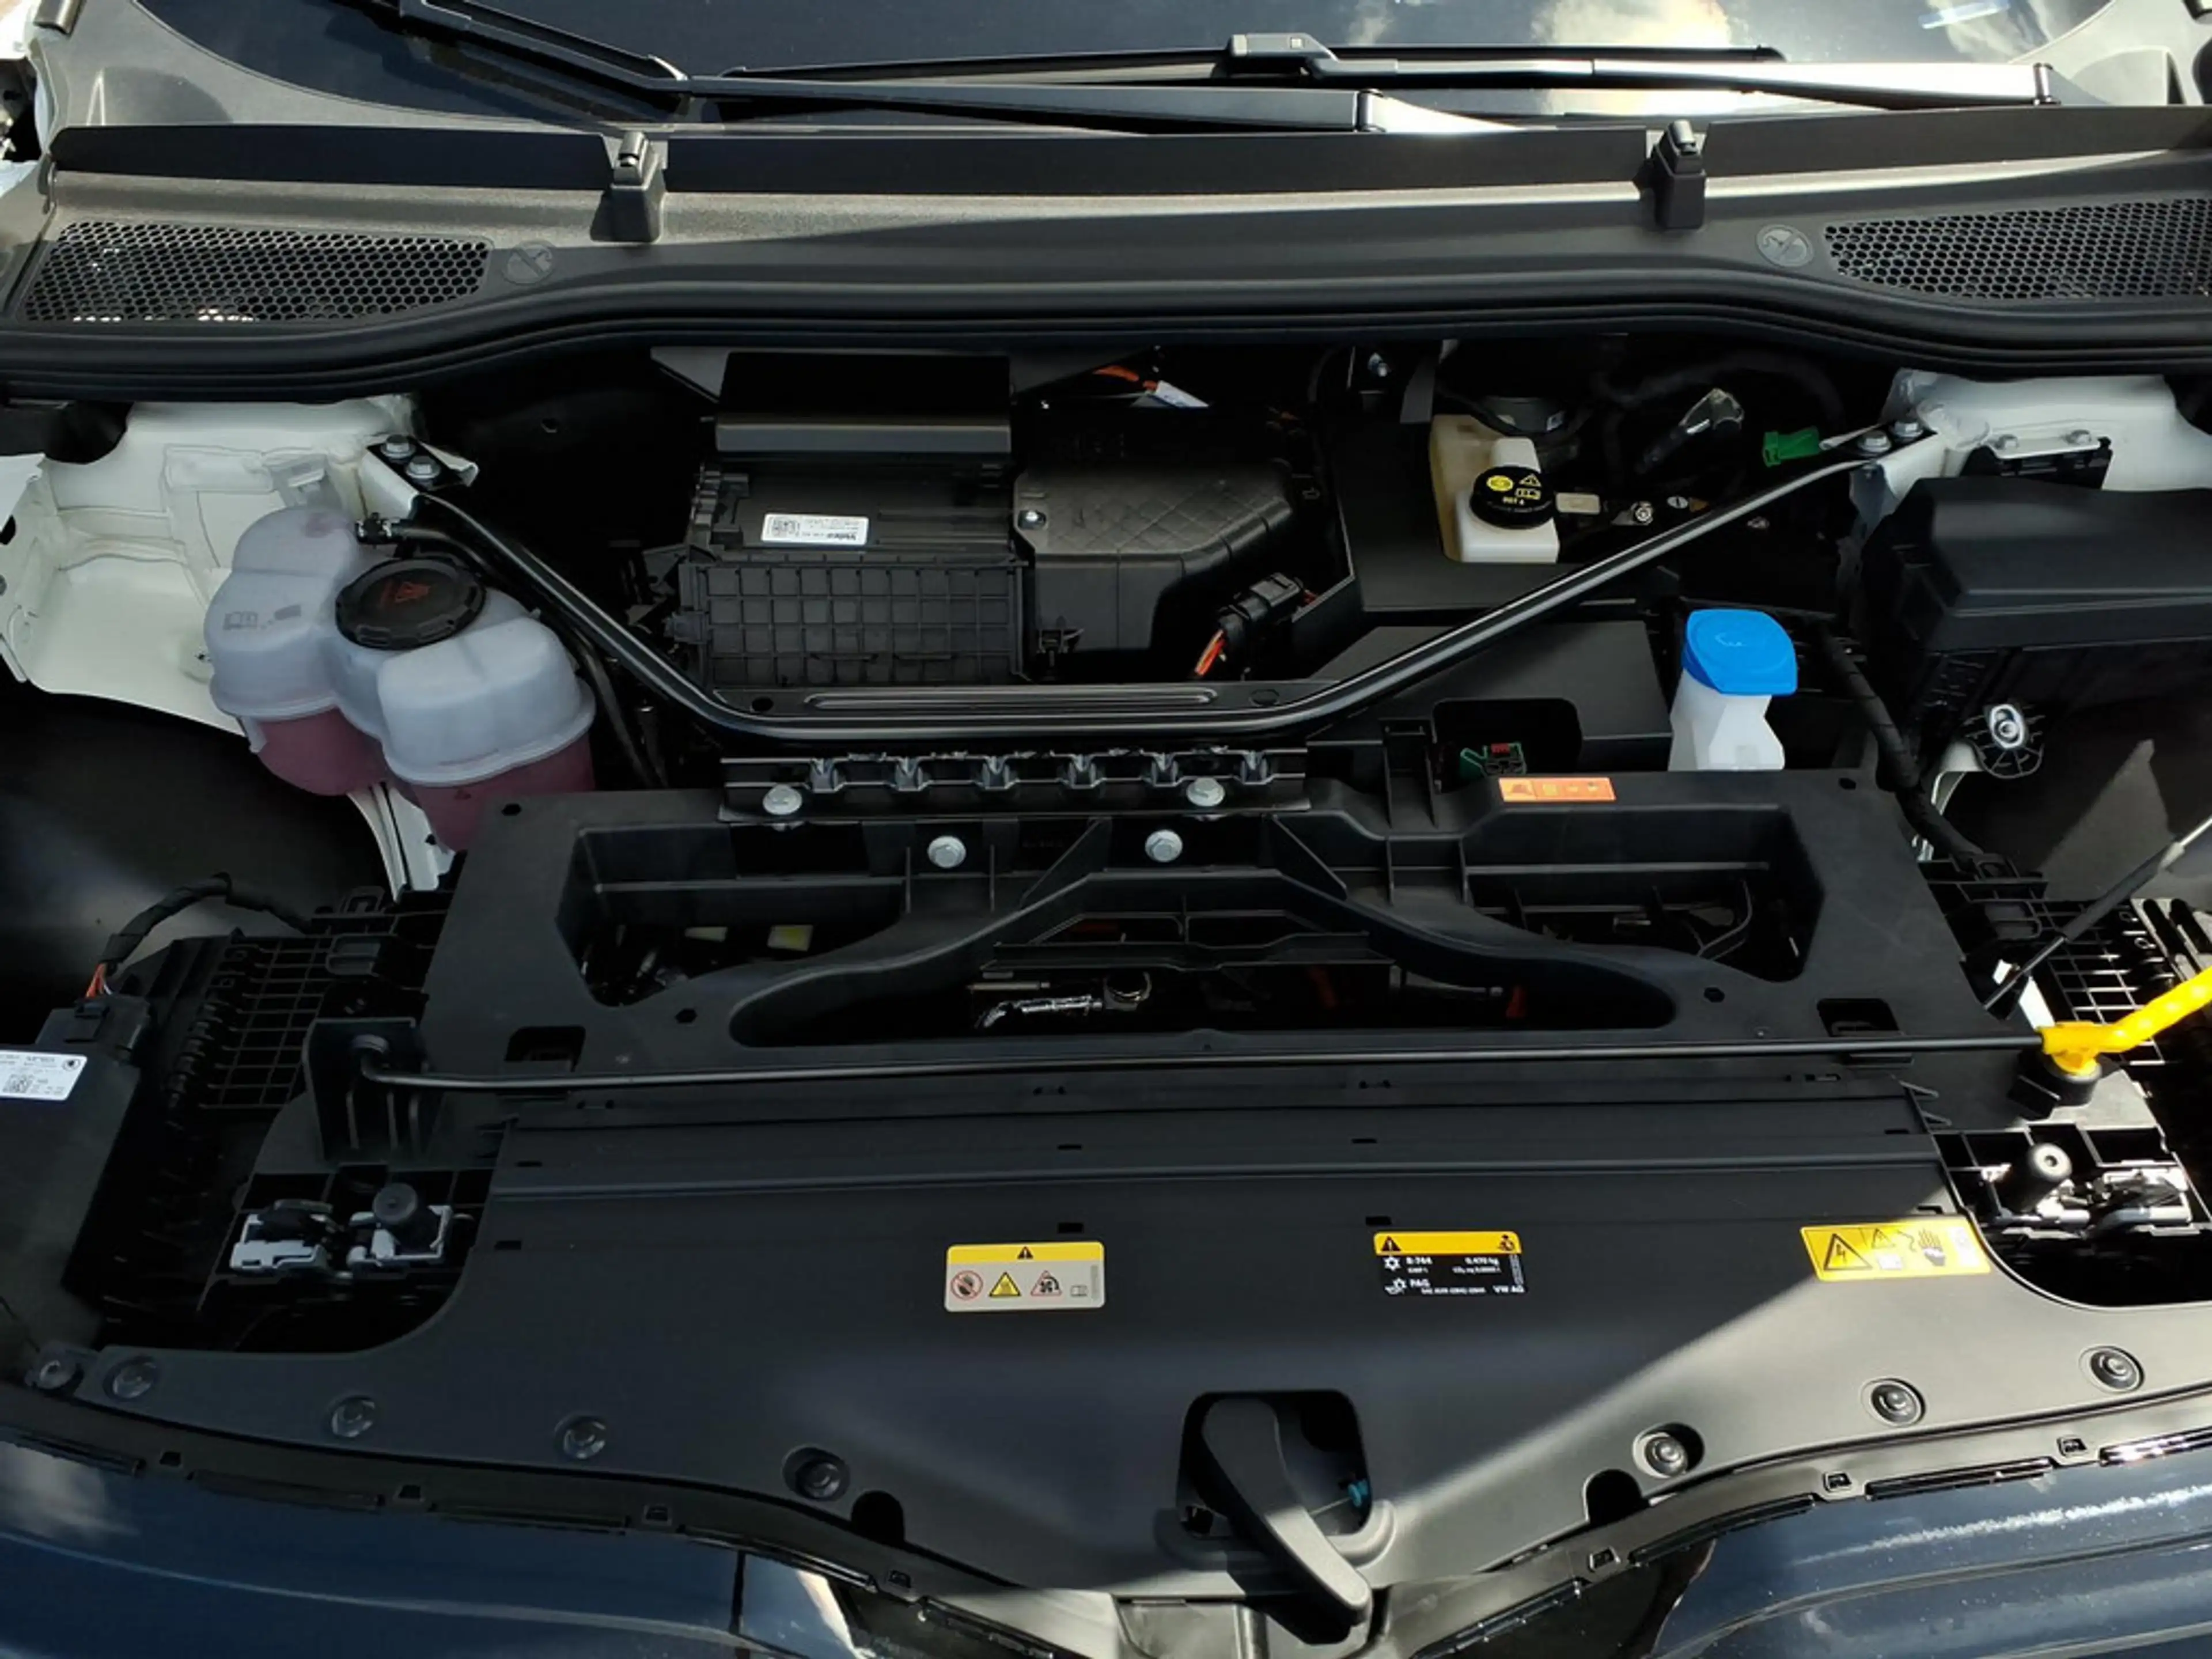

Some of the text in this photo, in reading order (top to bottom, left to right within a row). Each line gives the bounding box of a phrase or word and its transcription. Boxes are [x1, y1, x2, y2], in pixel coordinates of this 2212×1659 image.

[1410, 1279, 1431, 1287] PAG
[1493, 1285, 1509, 1293] VW
[1511, 1285, 1525, 1293] AG
